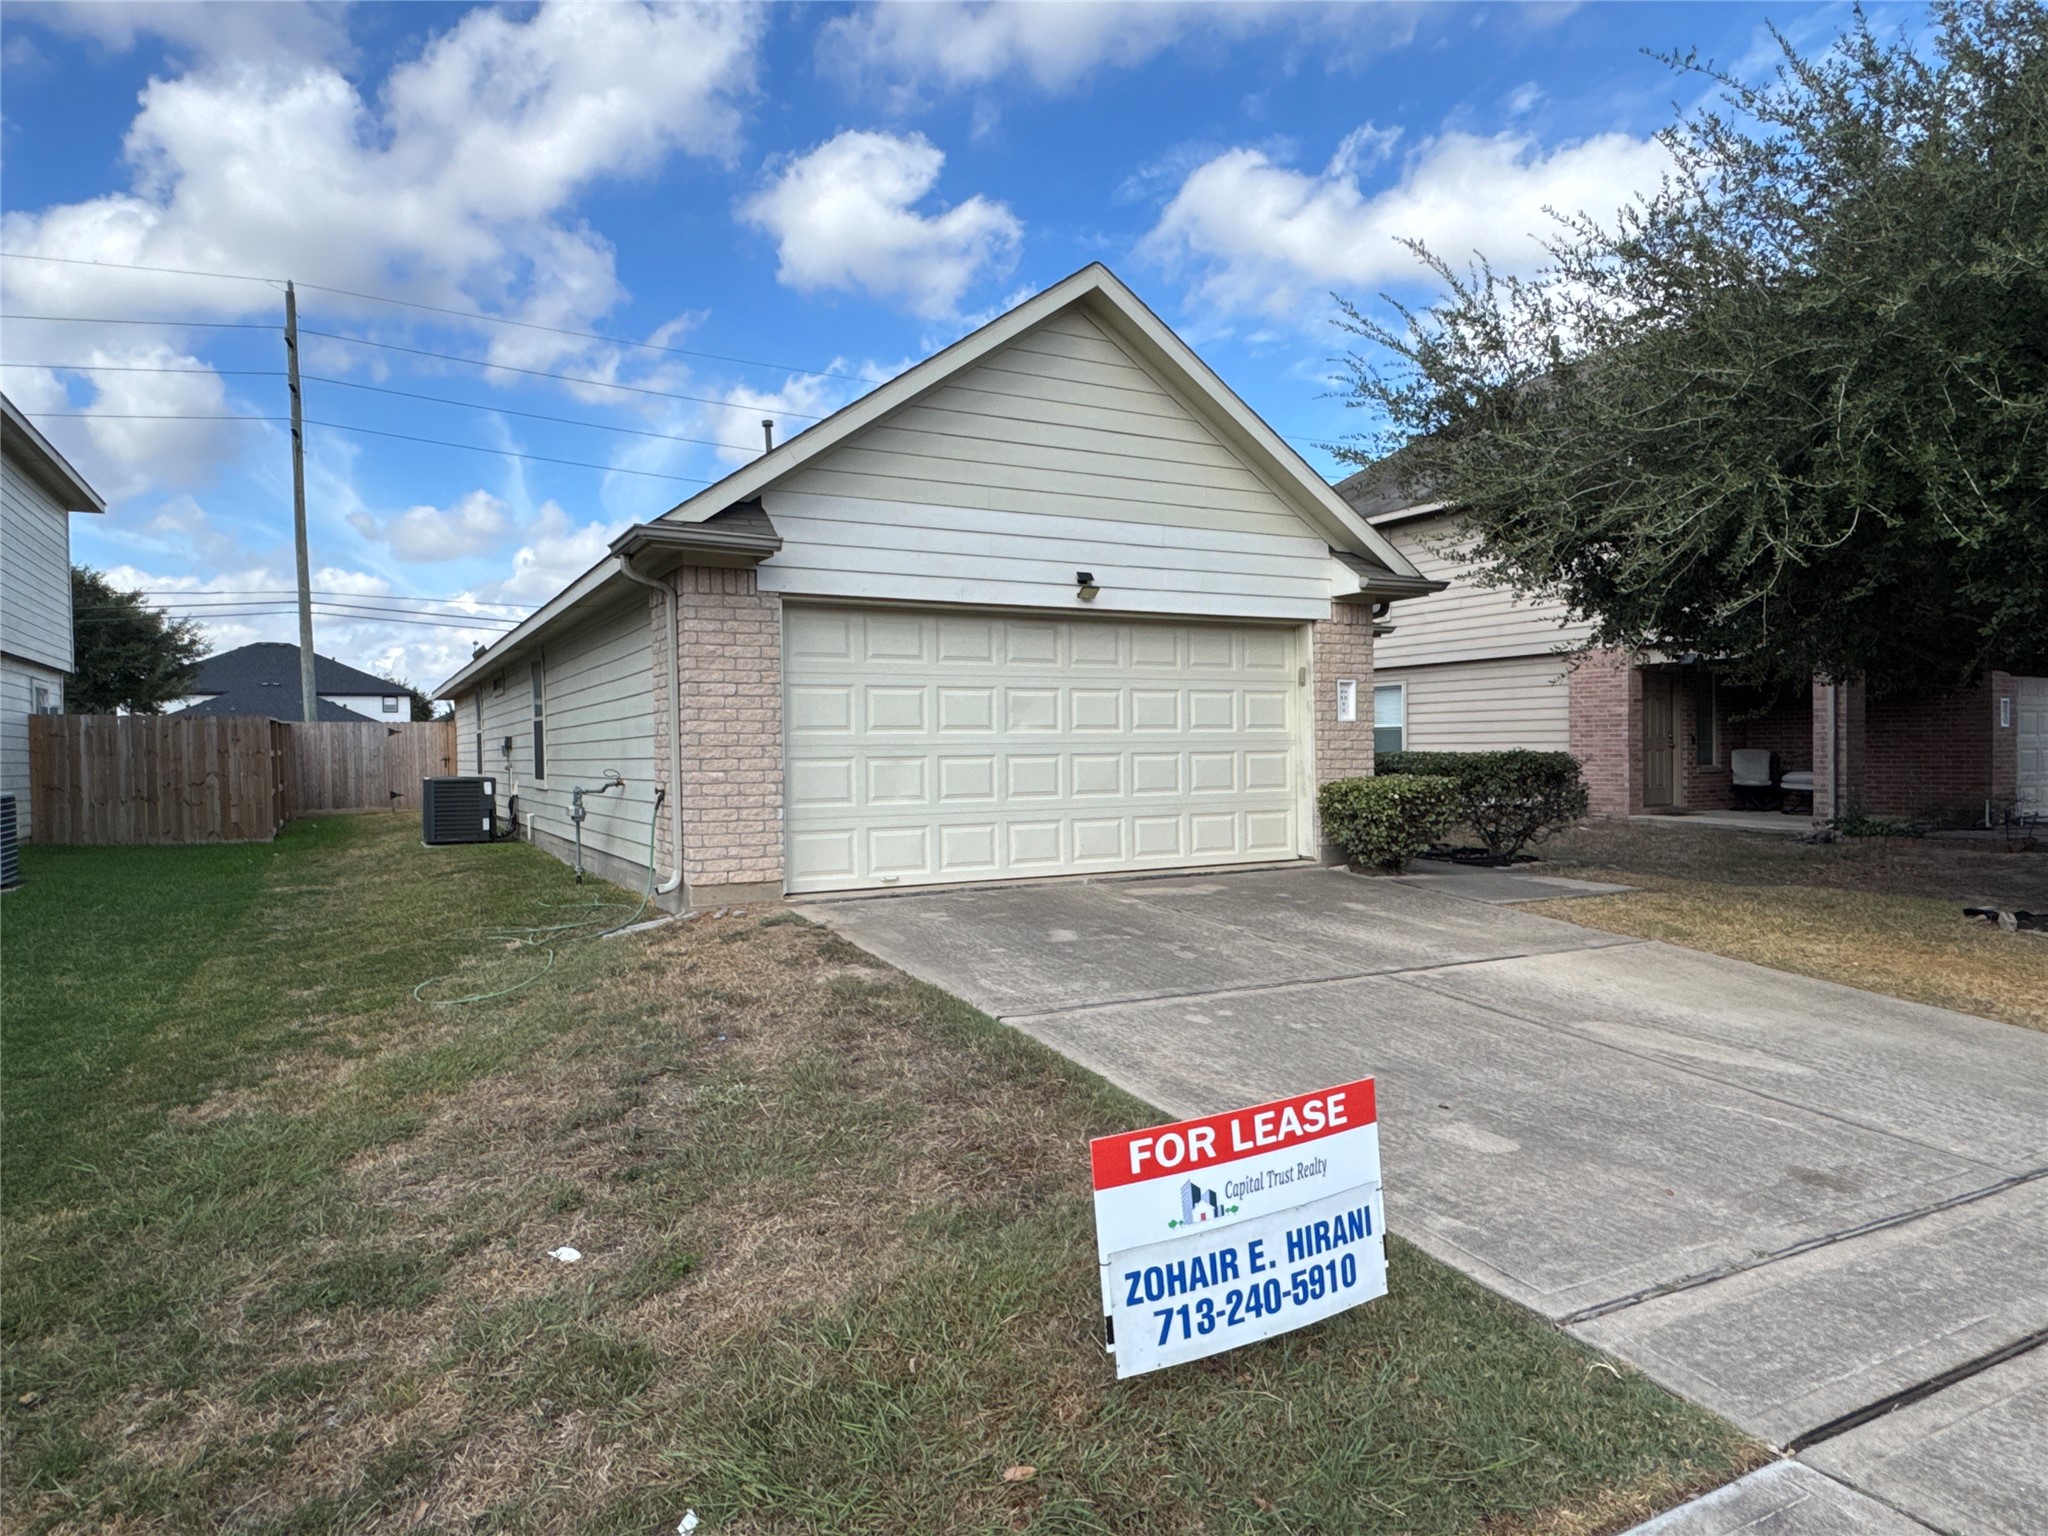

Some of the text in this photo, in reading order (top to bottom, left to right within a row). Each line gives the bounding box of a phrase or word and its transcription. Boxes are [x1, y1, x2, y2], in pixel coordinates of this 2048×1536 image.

[1129, 1092, 1348, 1174] FOR LEASE
[1225, 1156, 1327, 1200] Capital Trust Realty
[1124, 1204, 1373, 1307] ZOHAIR E. HIRANI
[1153, 1253, 1357, 1347] 713-240-5910
